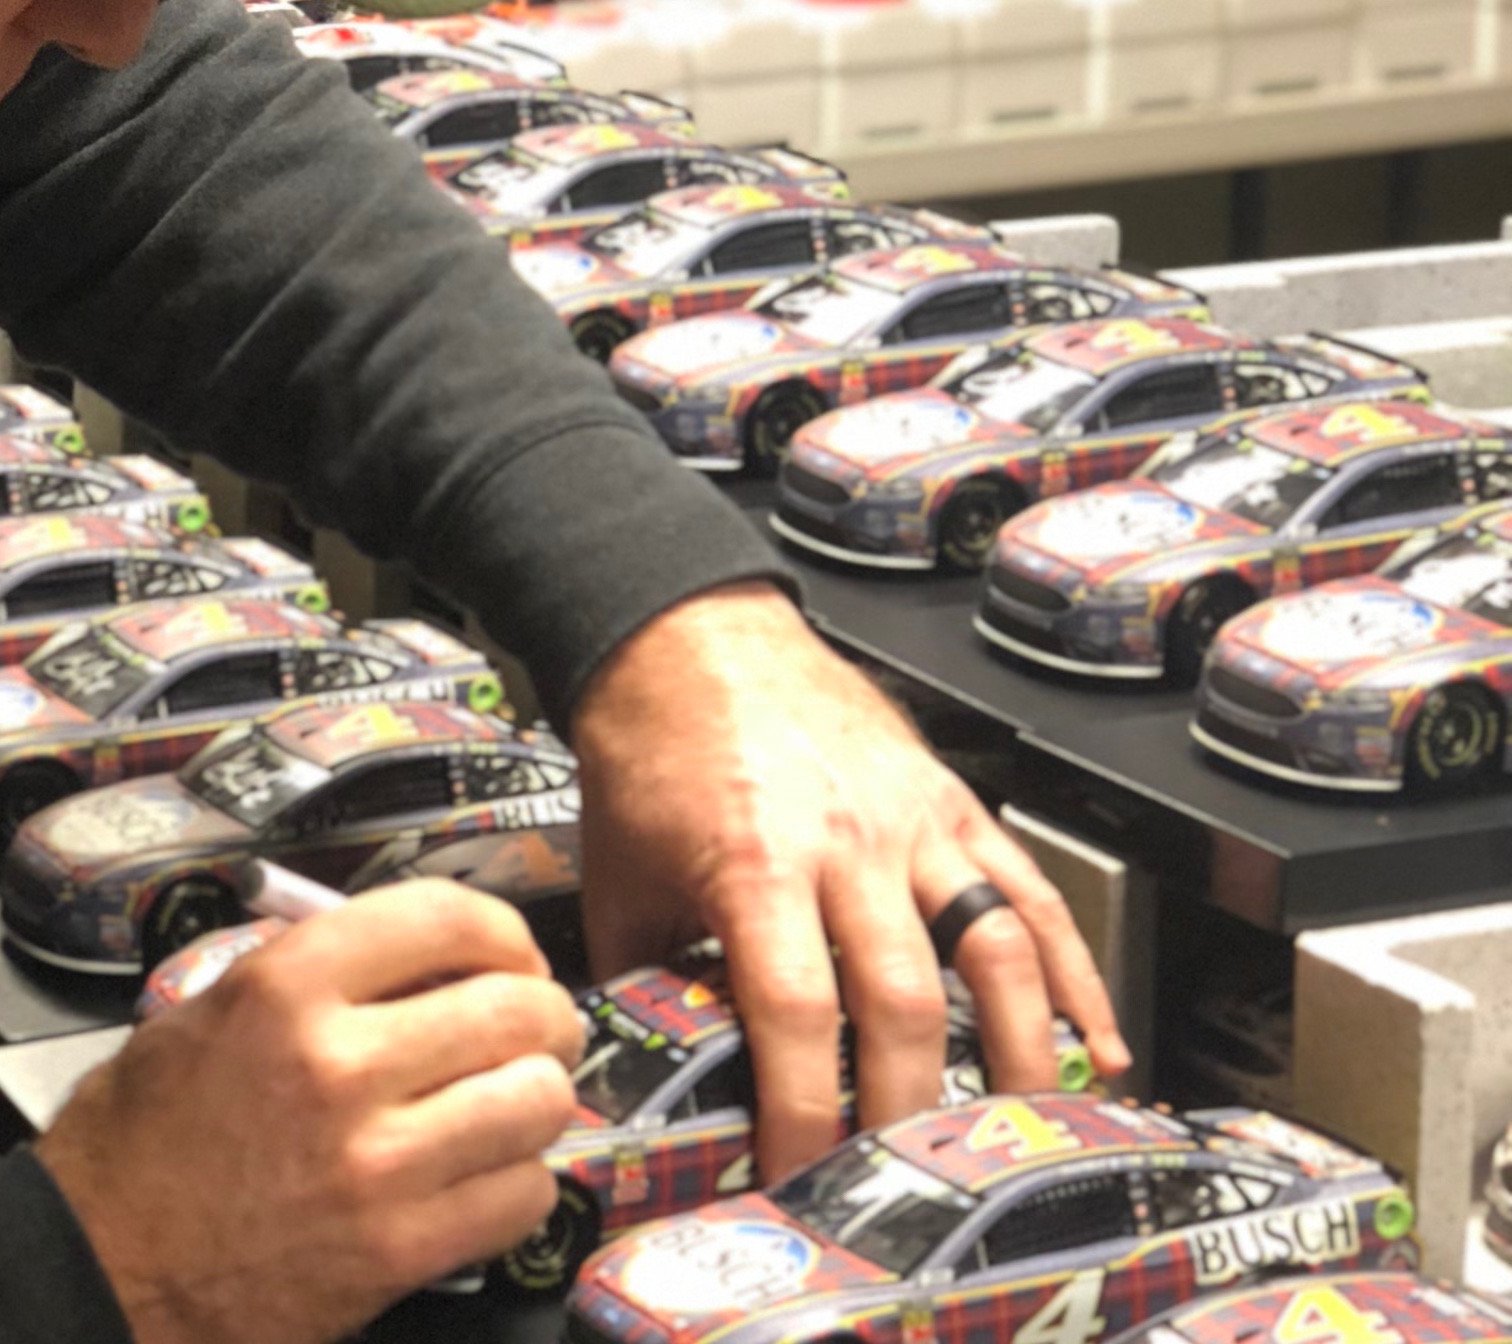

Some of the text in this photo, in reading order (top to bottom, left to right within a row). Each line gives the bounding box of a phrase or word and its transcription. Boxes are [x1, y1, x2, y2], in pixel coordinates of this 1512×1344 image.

[1320, 403, 1420, 442] 4
[325, 703, 420, 743] 4
[964, 1100, 1083, 1160] 4
[1195, 1202, 1353, 1275] BUSCH
